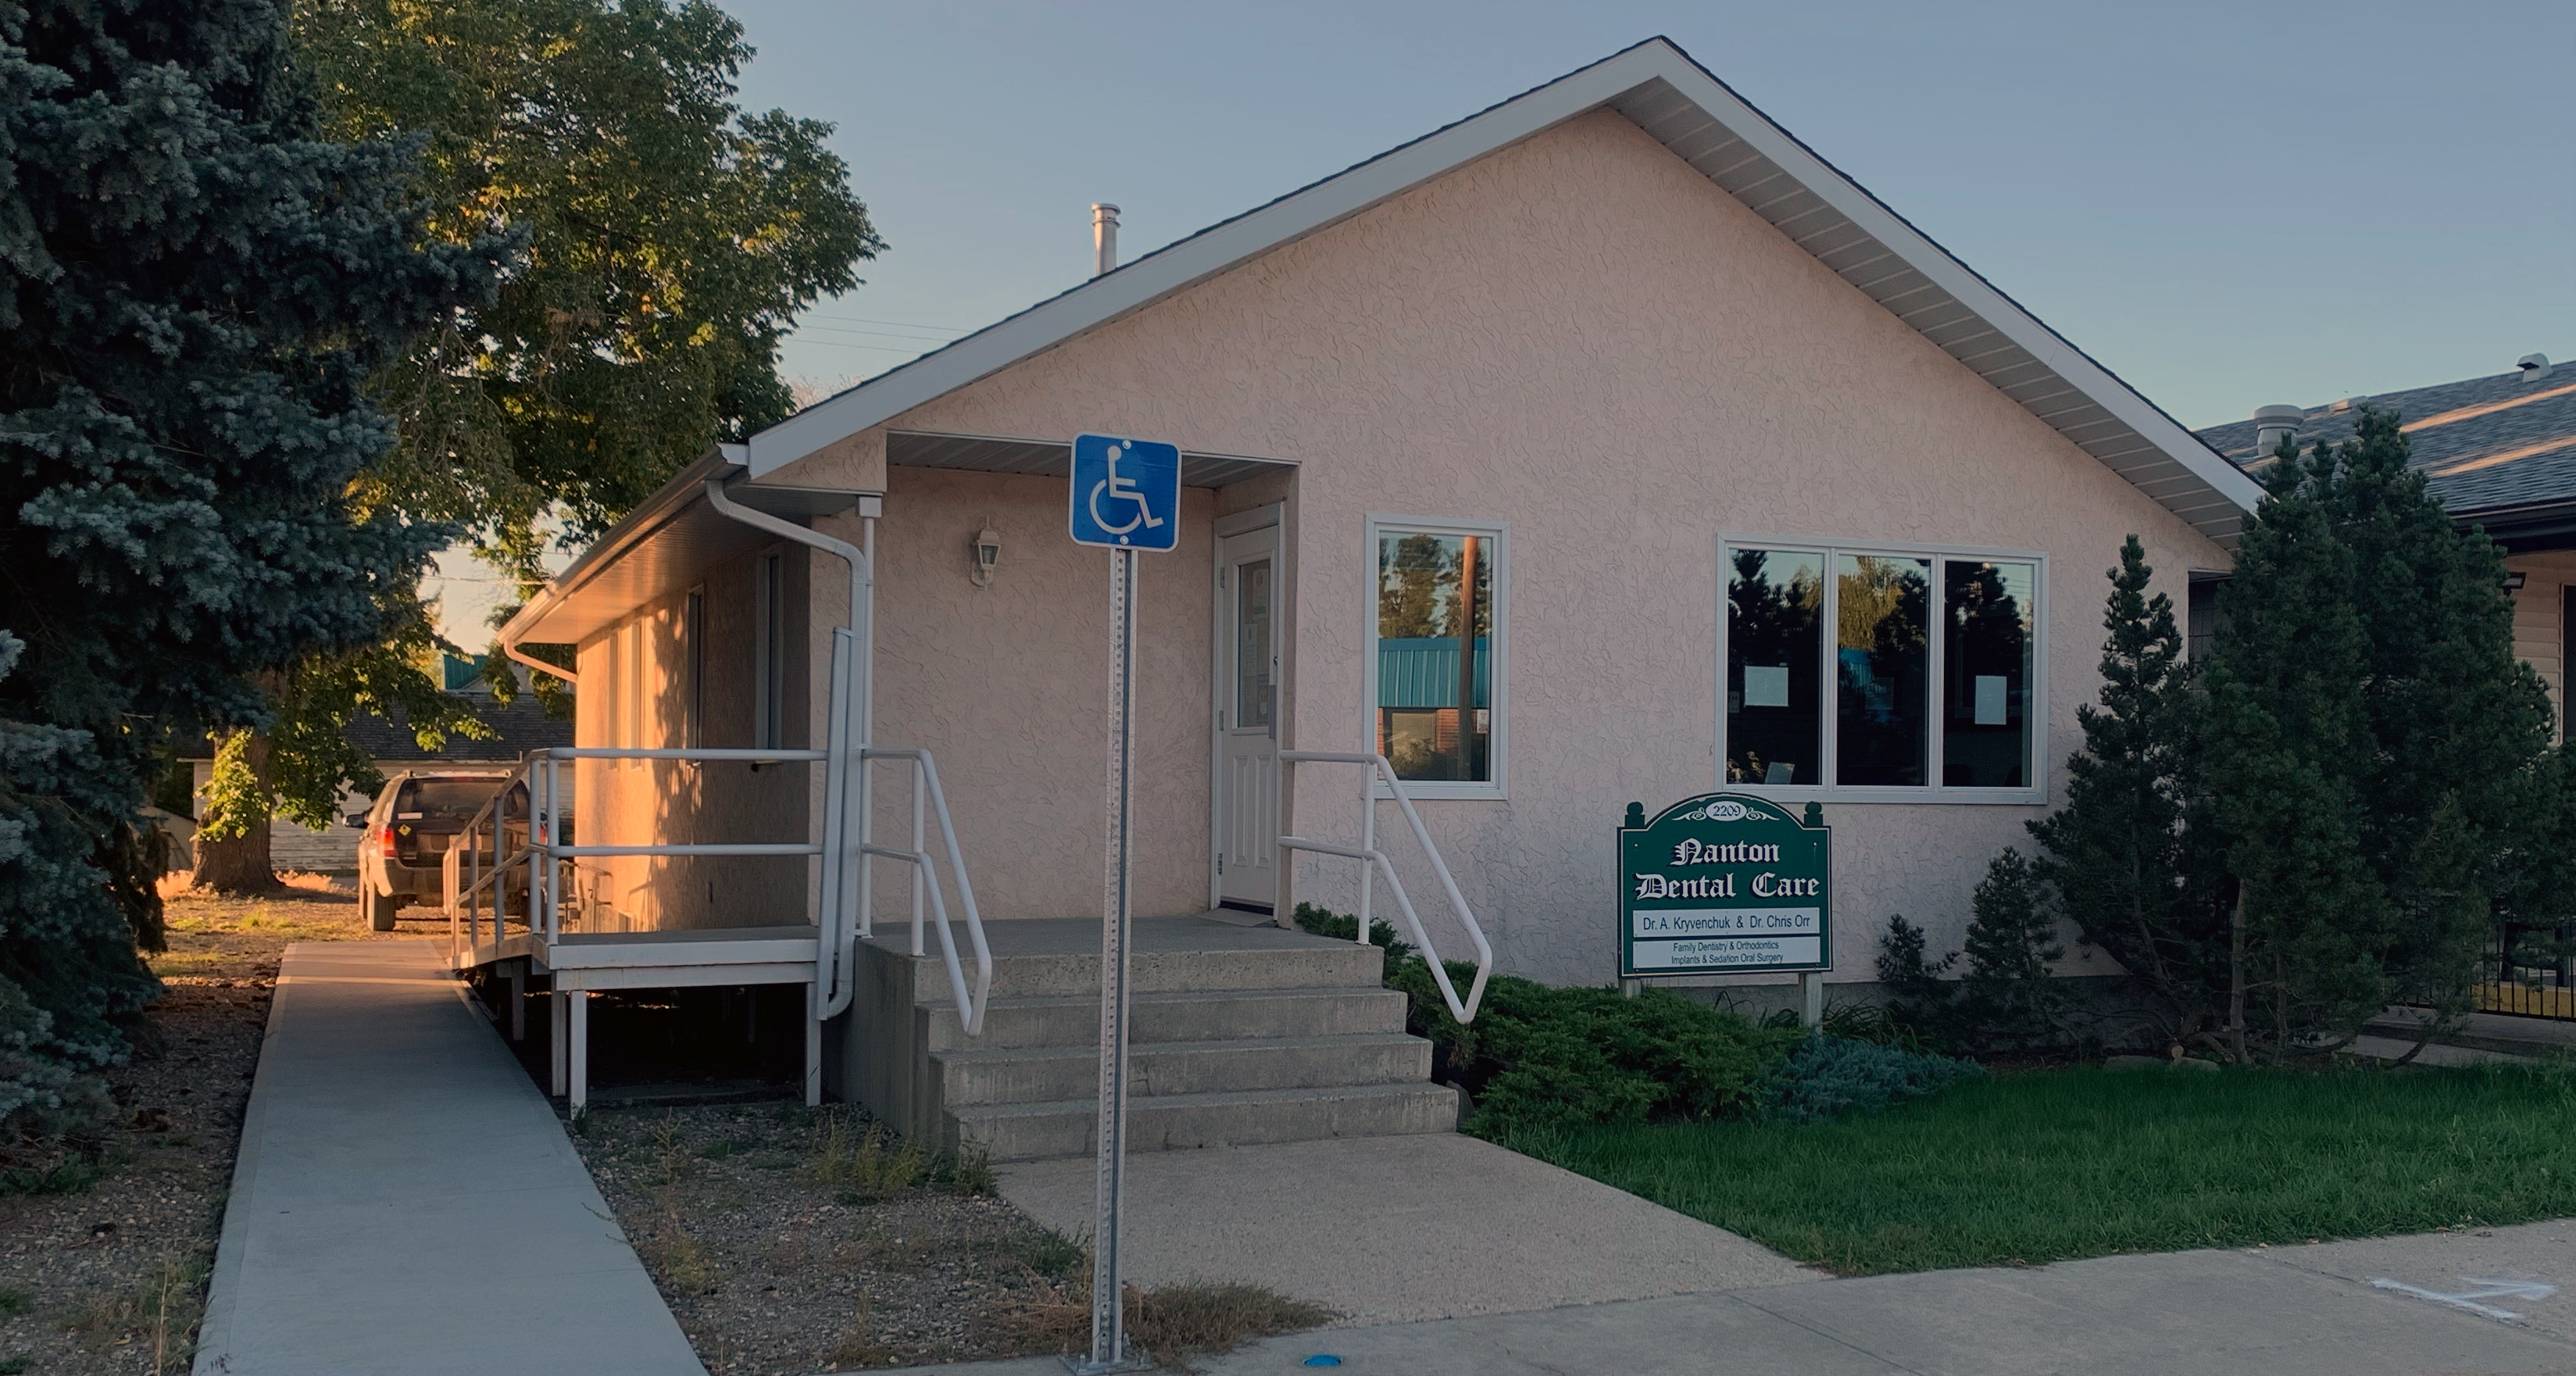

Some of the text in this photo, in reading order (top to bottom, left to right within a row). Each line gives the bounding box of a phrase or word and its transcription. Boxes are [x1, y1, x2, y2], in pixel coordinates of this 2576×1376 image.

[1713, 805, 1741, 817] 2209
[1670, 838, 1780, 865] Nanton
[1635, 872, 1820, 900] Dental Care
[1643, 914, 1810, 932] Dr. A. Kryvenchuk & Dr. Chris Orr
[1674, 940, 1779, 953] Family Dentistry & Orthodontics
[1671, 952, 1784, 965] Implants & Sedation Oral Surgery
